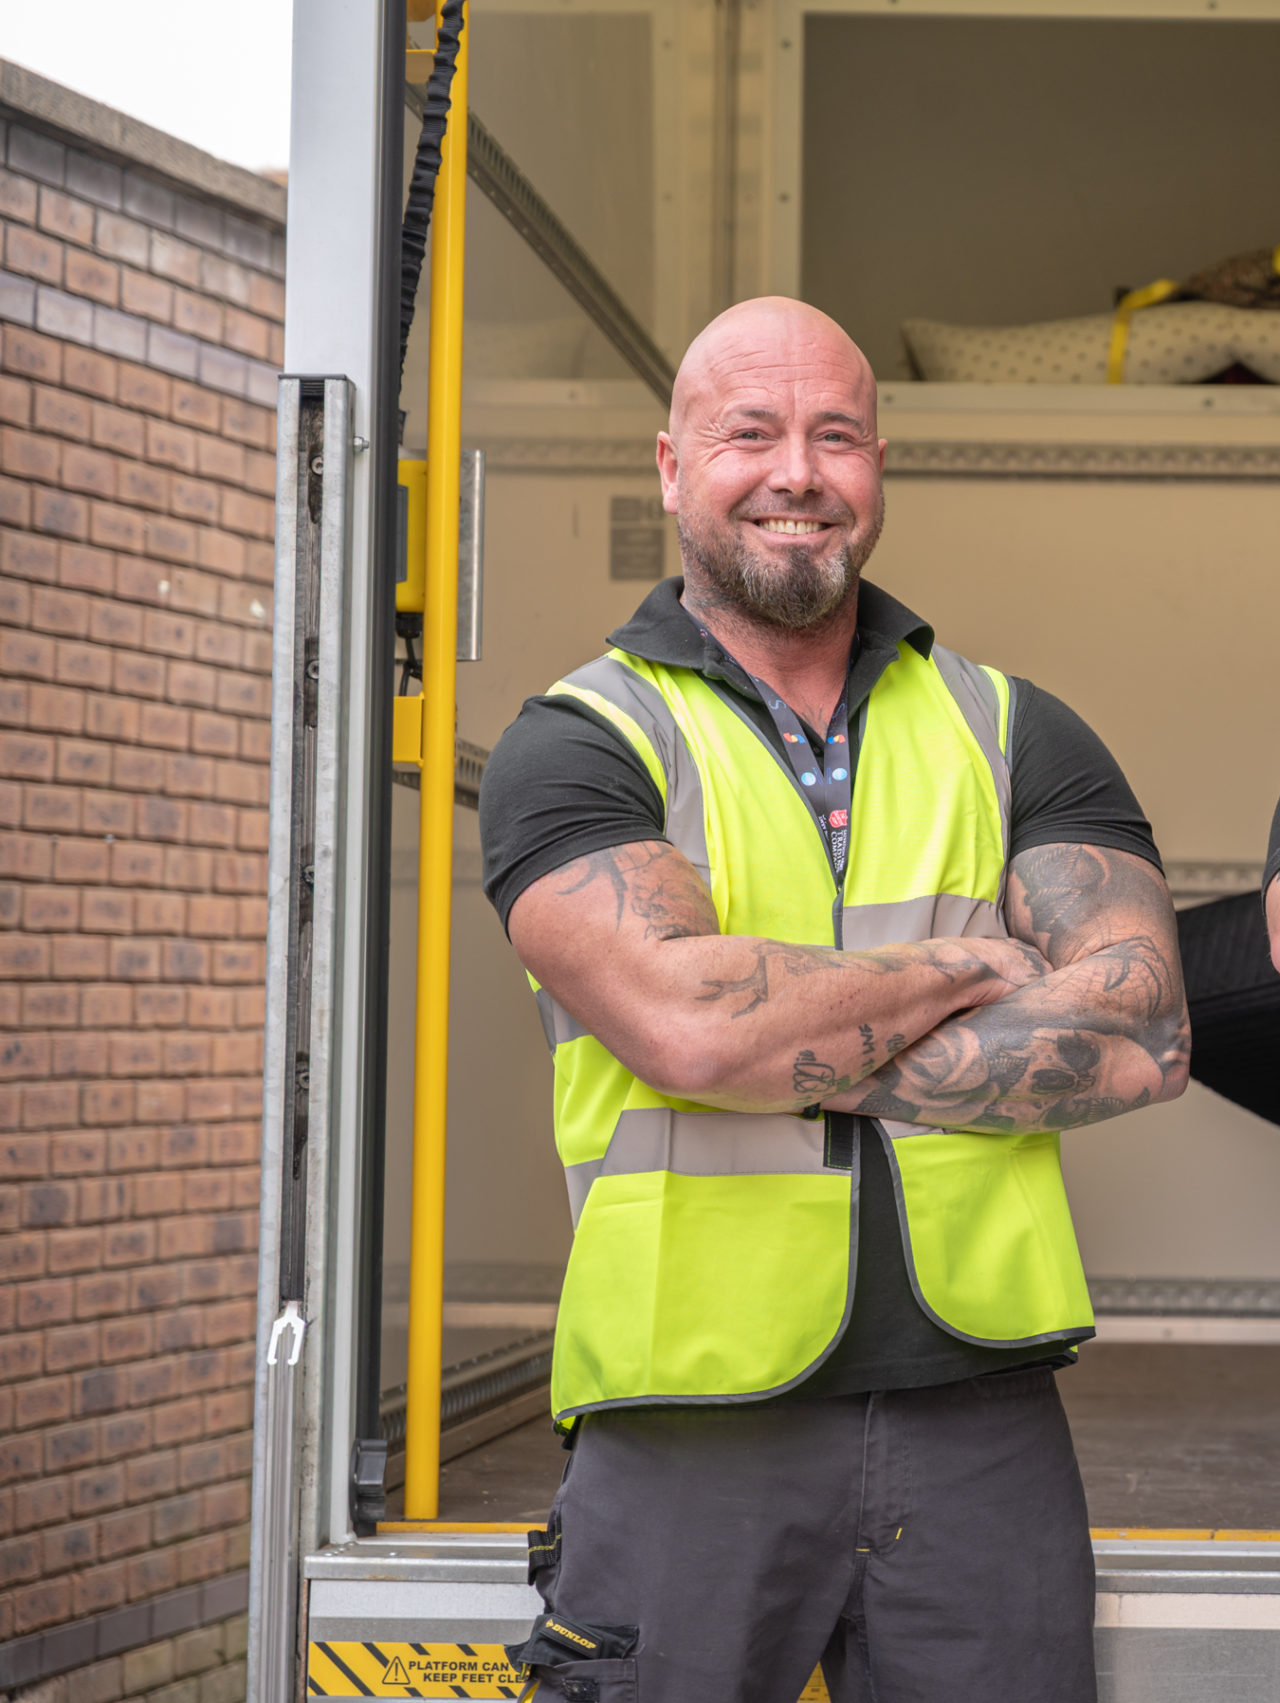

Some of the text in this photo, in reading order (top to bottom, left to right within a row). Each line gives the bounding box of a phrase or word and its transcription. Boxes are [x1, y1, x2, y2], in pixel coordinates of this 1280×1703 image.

[551, 1623, 597, 1649] DUNLOP
[408, 1660, 509, 1672] PLATFORM CAN
[423, 1672, 526, 1684] KEEP FEET CLE
